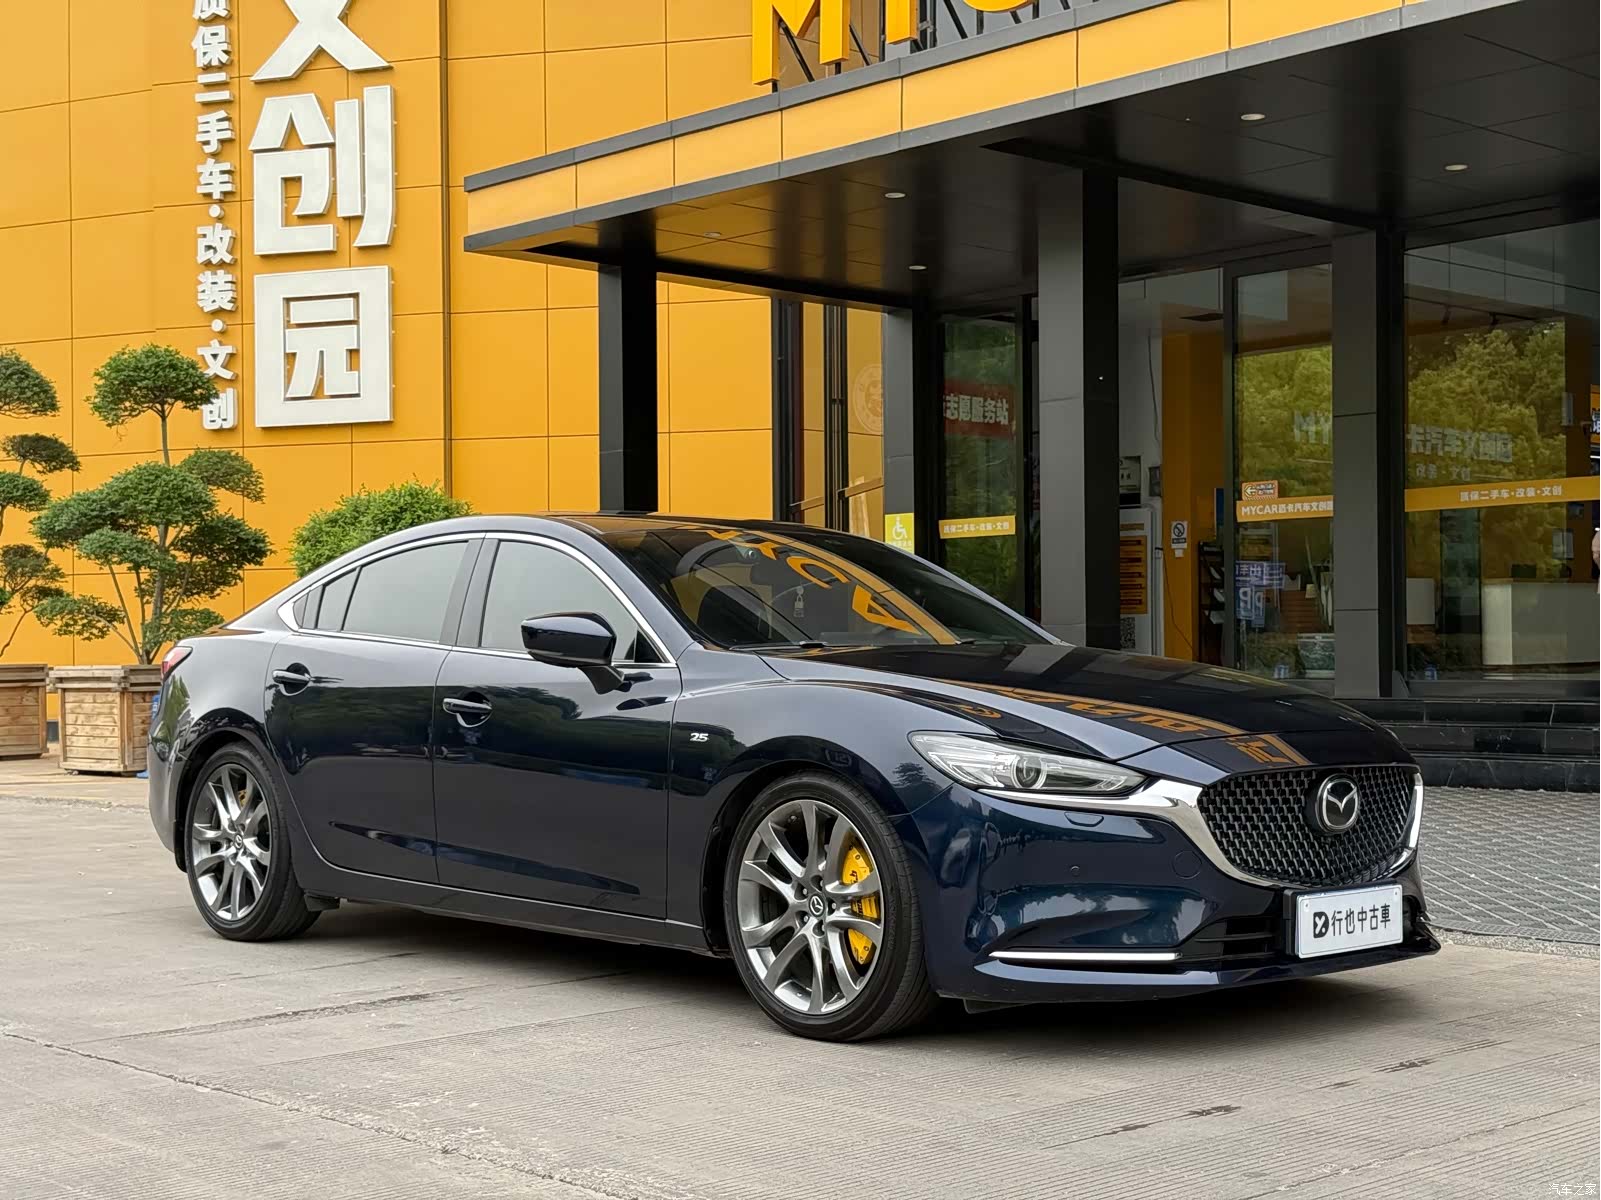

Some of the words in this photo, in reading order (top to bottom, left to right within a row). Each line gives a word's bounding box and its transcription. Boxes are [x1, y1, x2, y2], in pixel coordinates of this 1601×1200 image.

[943, 393, 1009, 425] 志愿服务站
[689, 732, 709, 743] 25
[1331, 903, 1391, 936] 行也中古車
